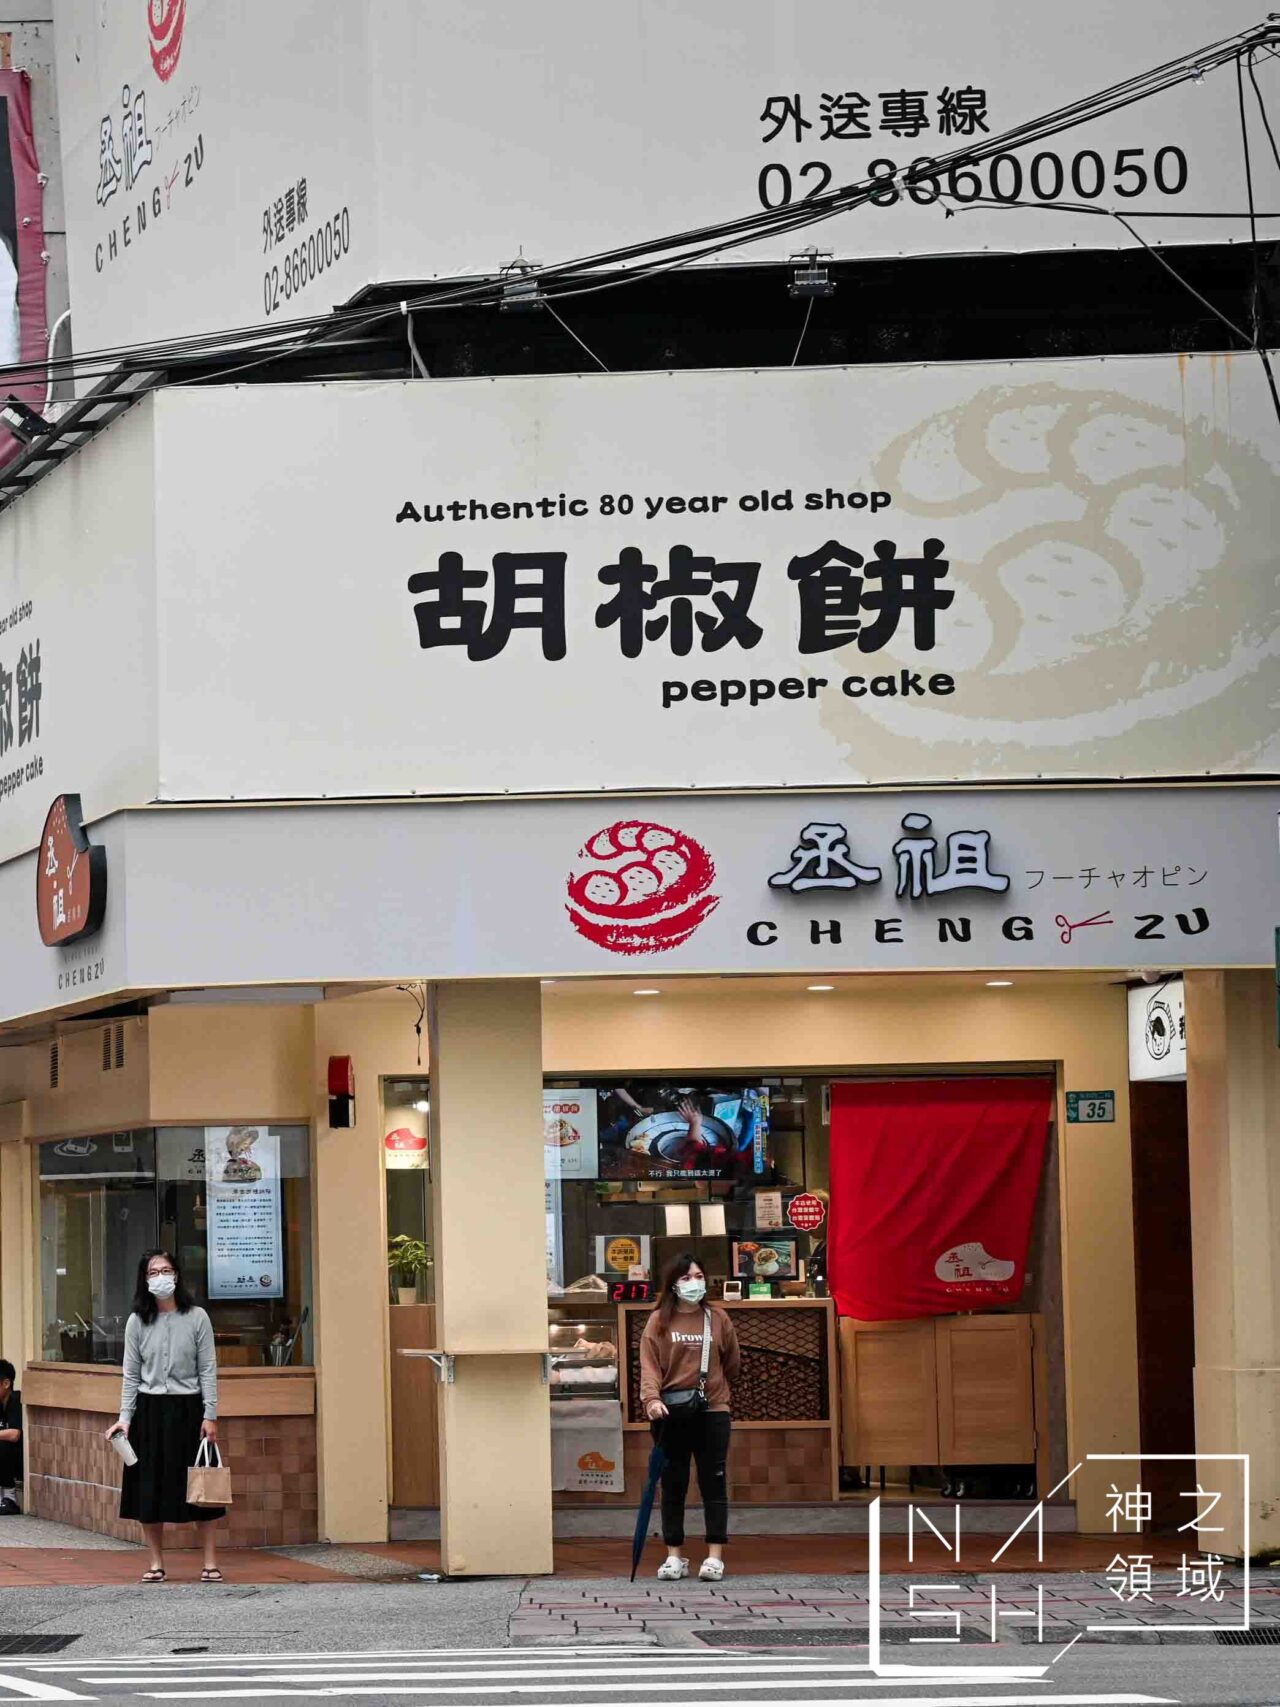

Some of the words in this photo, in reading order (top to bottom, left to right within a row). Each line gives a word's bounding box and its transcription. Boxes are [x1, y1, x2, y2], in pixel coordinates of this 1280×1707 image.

[759, 86, 991, 143] 外送專線
[95, 186, 161, 273] CHENG
[184, 134, 205, 188] ZU
[758, 146, 1189, 212] 02-86600050
[263, 176, 308, 254] 外送專線
[263, 206, 350, 316] 02-86600050
[394, 494, 589, 523] Authentic
[598, 494, 634, 516] 80
[645, 496, 728, 520] year
[738, 489, 793, 512] old
[805, 488, 892, 514] shop
[407, 538, 956, 662] 胡椒餅
[662, 673, 828, 709] pepper
[841, 669, 956, 698] cake
[0, 770, 25, 802] pepper
[25, 754, 44, 787] cake
[767, 812, 1010, 900] 丞祖
[1023, 865, 1210, 890] フーチャオピン
[746, 916, 1034, 946] CHENG
[1134, 906, 1210, 941] ZU
[1087, 1101, 1107, 1118] 35
[613, 1284, 648, 1300] 217
